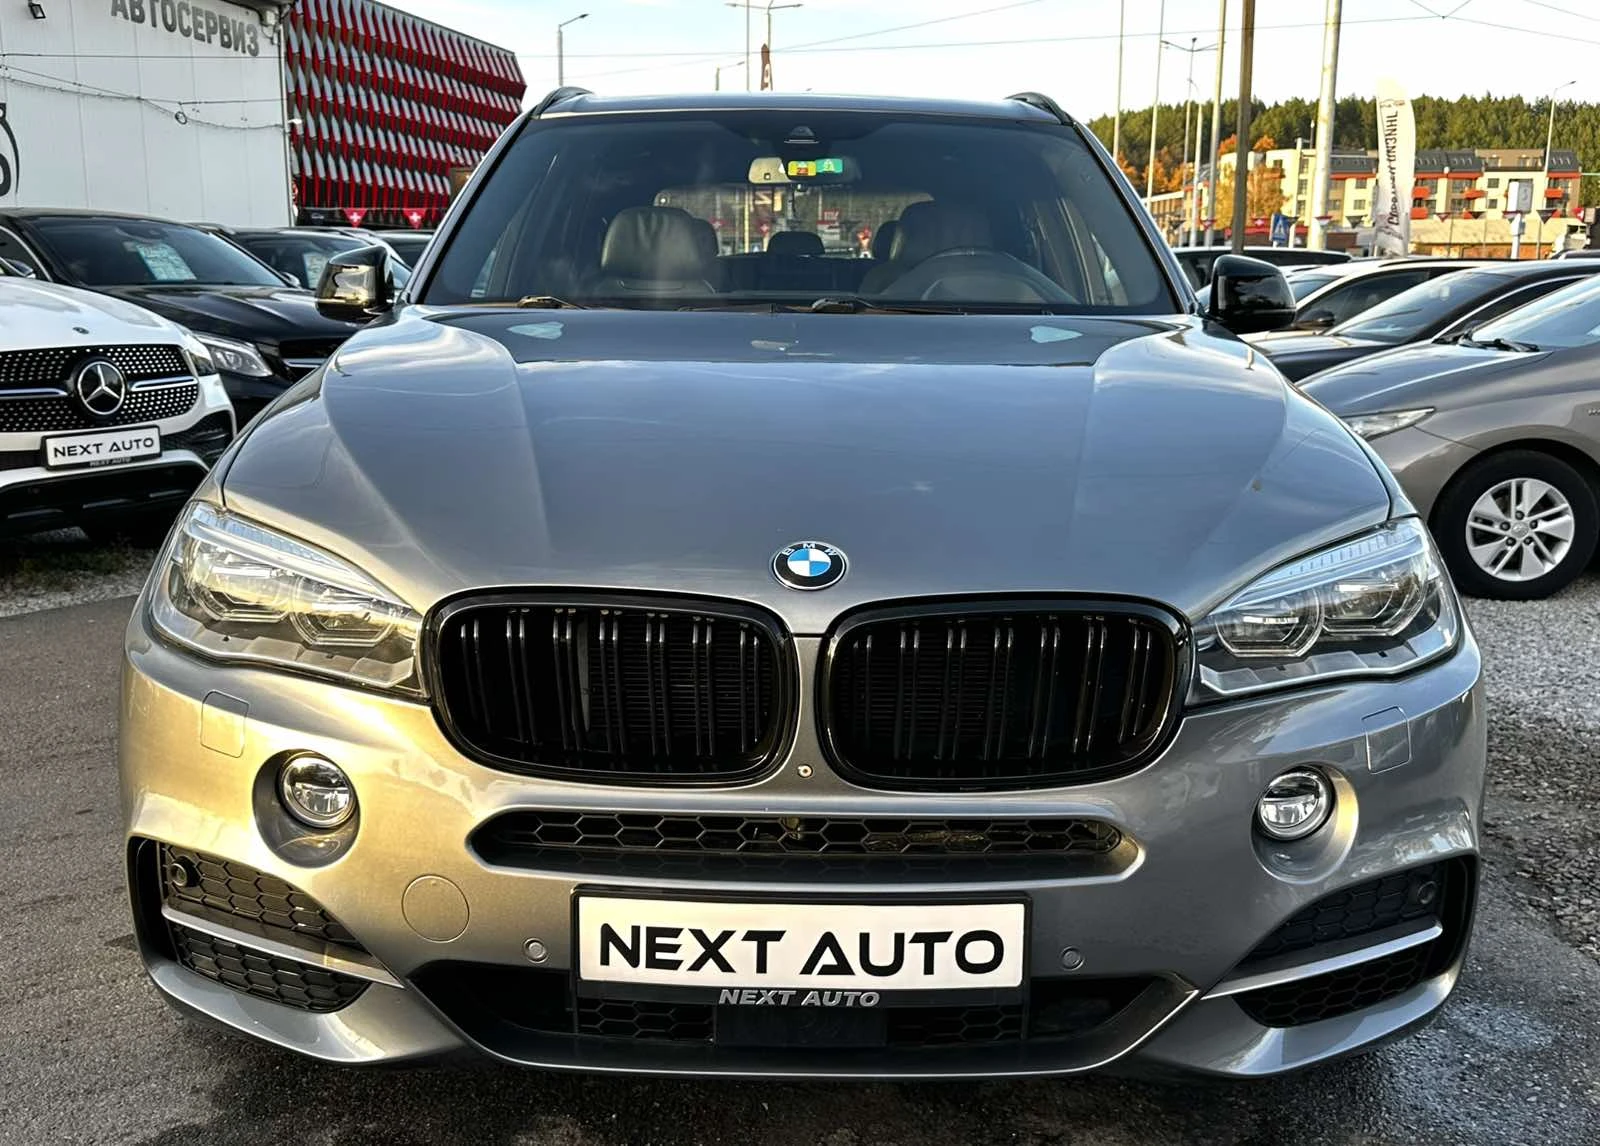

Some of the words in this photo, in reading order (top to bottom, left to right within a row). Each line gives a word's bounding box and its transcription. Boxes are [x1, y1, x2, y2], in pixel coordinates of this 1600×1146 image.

[111, 0, 259, 57] АВТОСЕРВИЗ
[54, 443, 103, 458] NEXT
[109, 437, 154, 453] AUTO
[781, 543, 837, 556] BMW
[600, 922, 787, 974] NEXT
[799, 929, 1005, 977] AUTO
[718, 989, 796, 1006] NEXT
[801, 990, 880, 1007] AUTO
